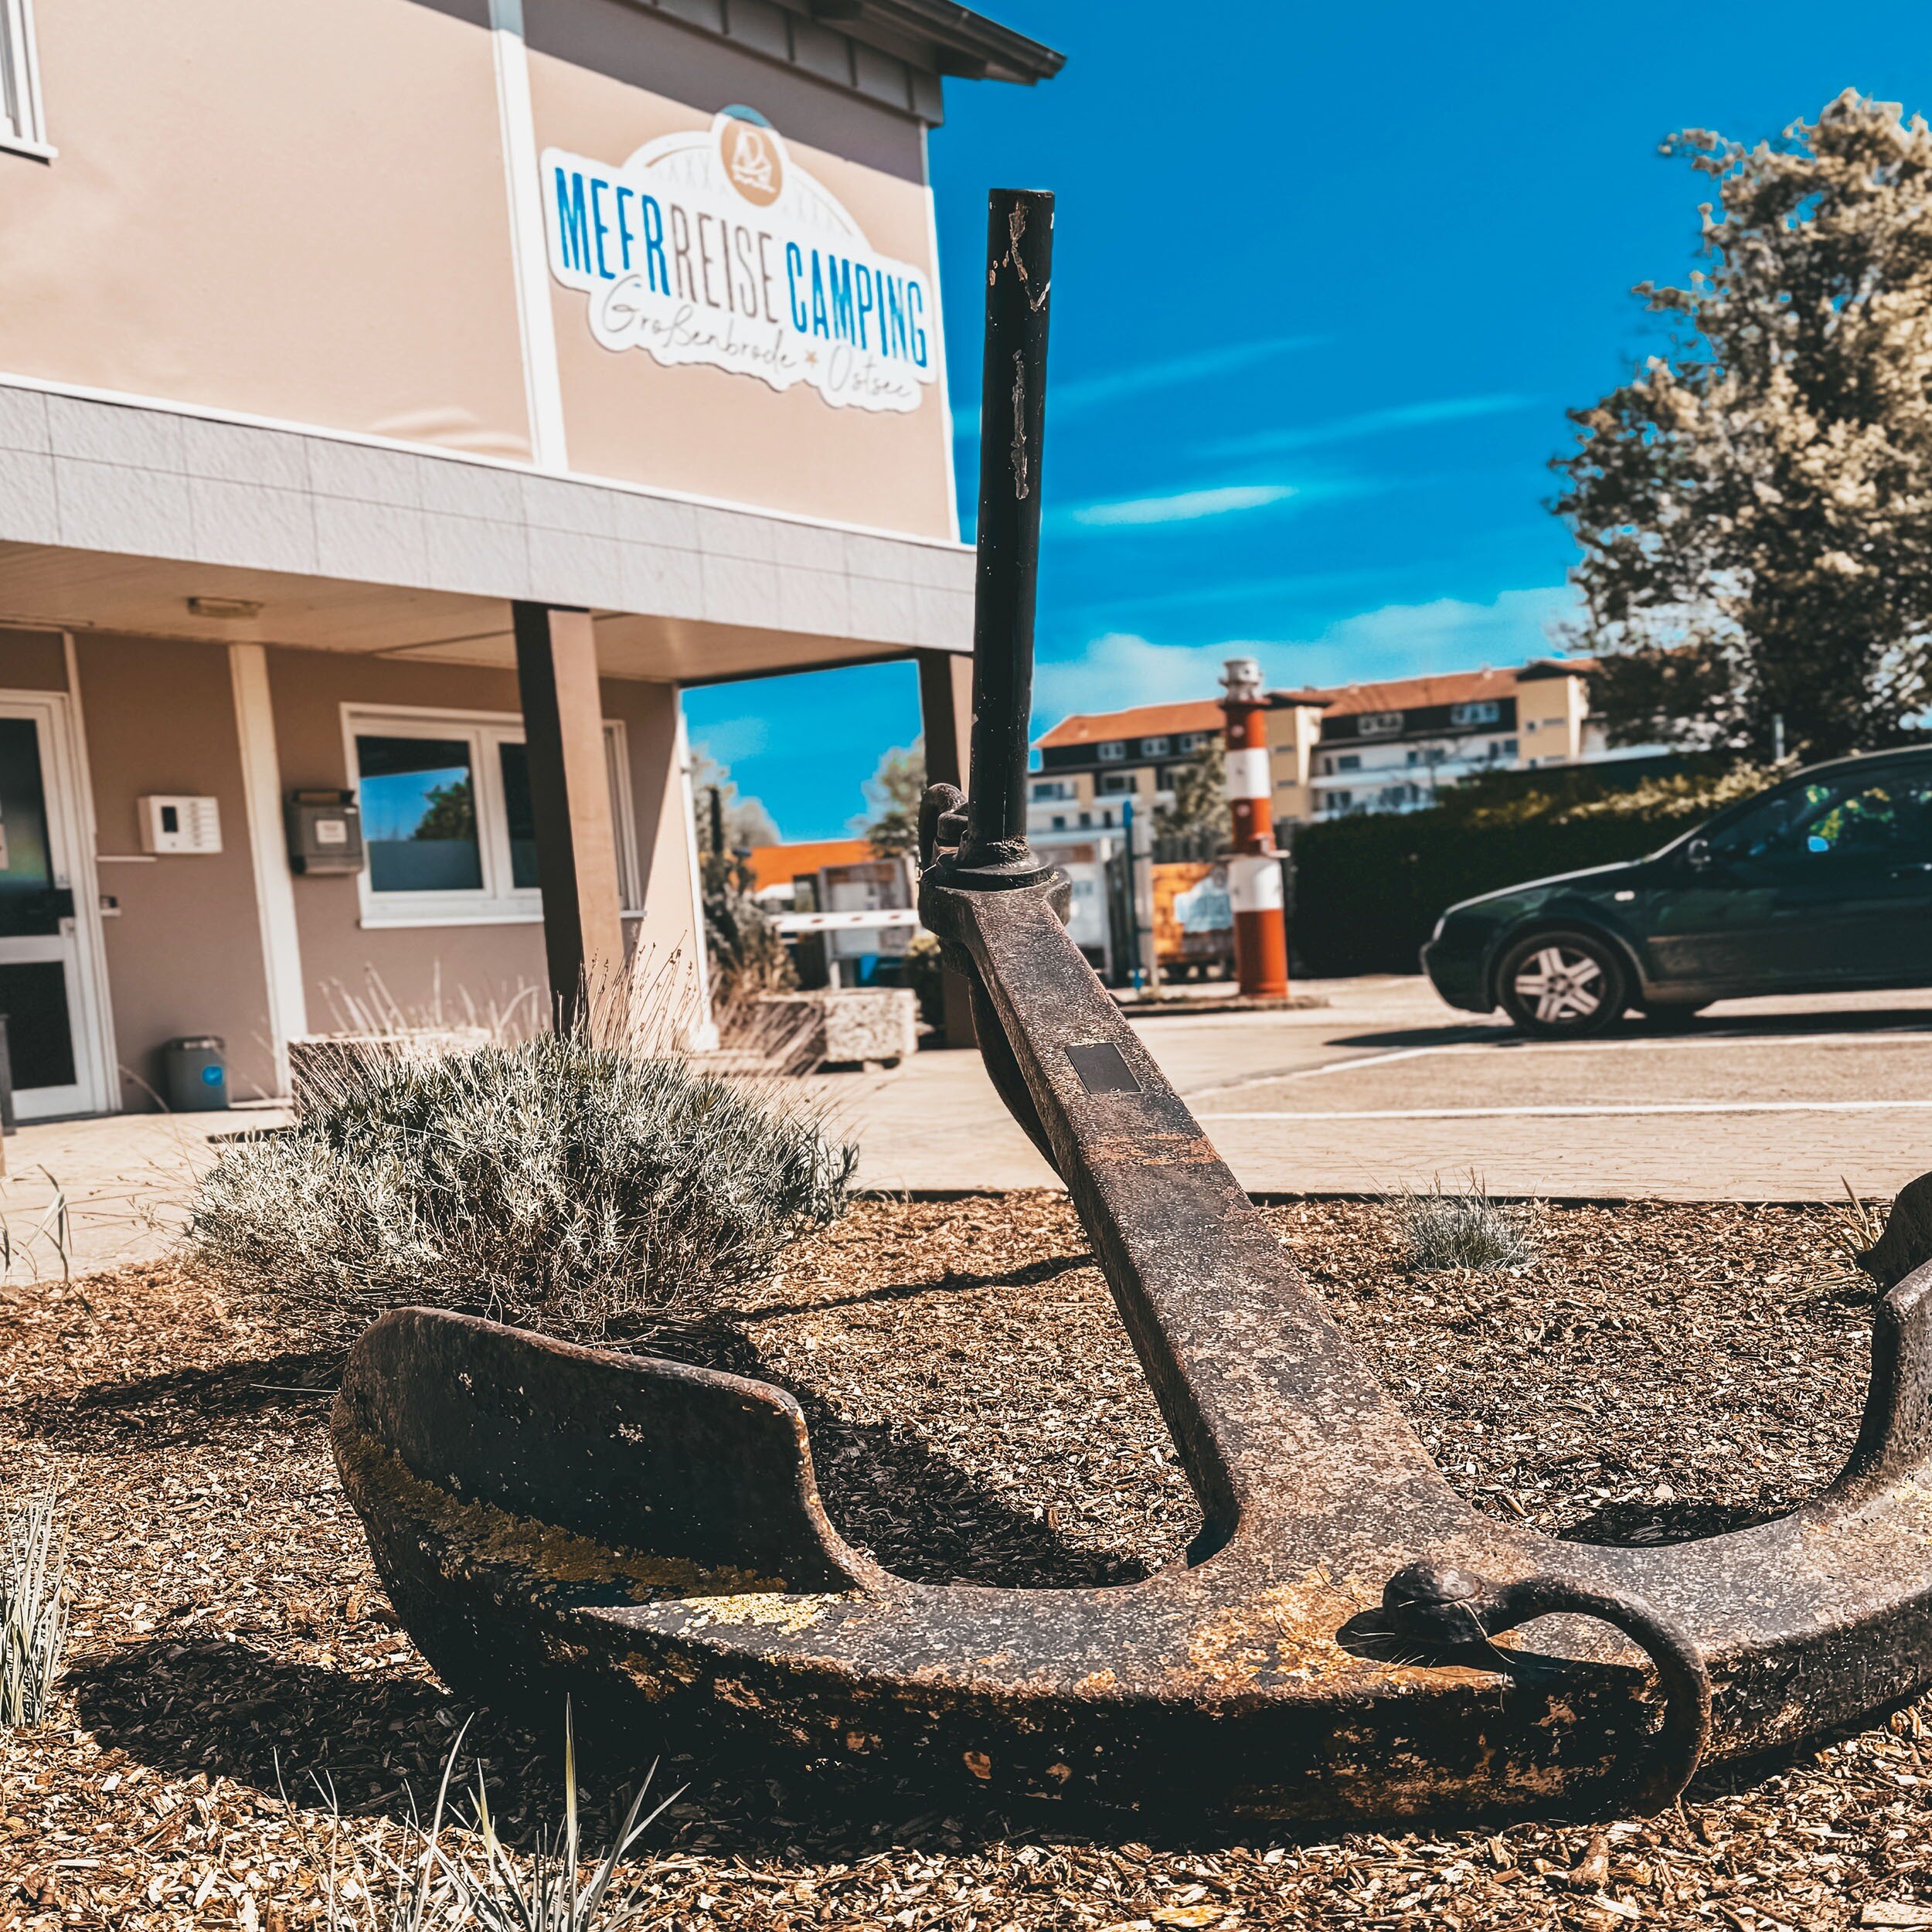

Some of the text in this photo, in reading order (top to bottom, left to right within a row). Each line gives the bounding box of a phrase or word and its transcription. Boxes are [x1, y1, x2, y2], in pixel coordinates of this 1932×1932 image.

[601, 273, 911, 397] Großenbrode Ostsee
[785, 241, 927, 368] CAMPING
